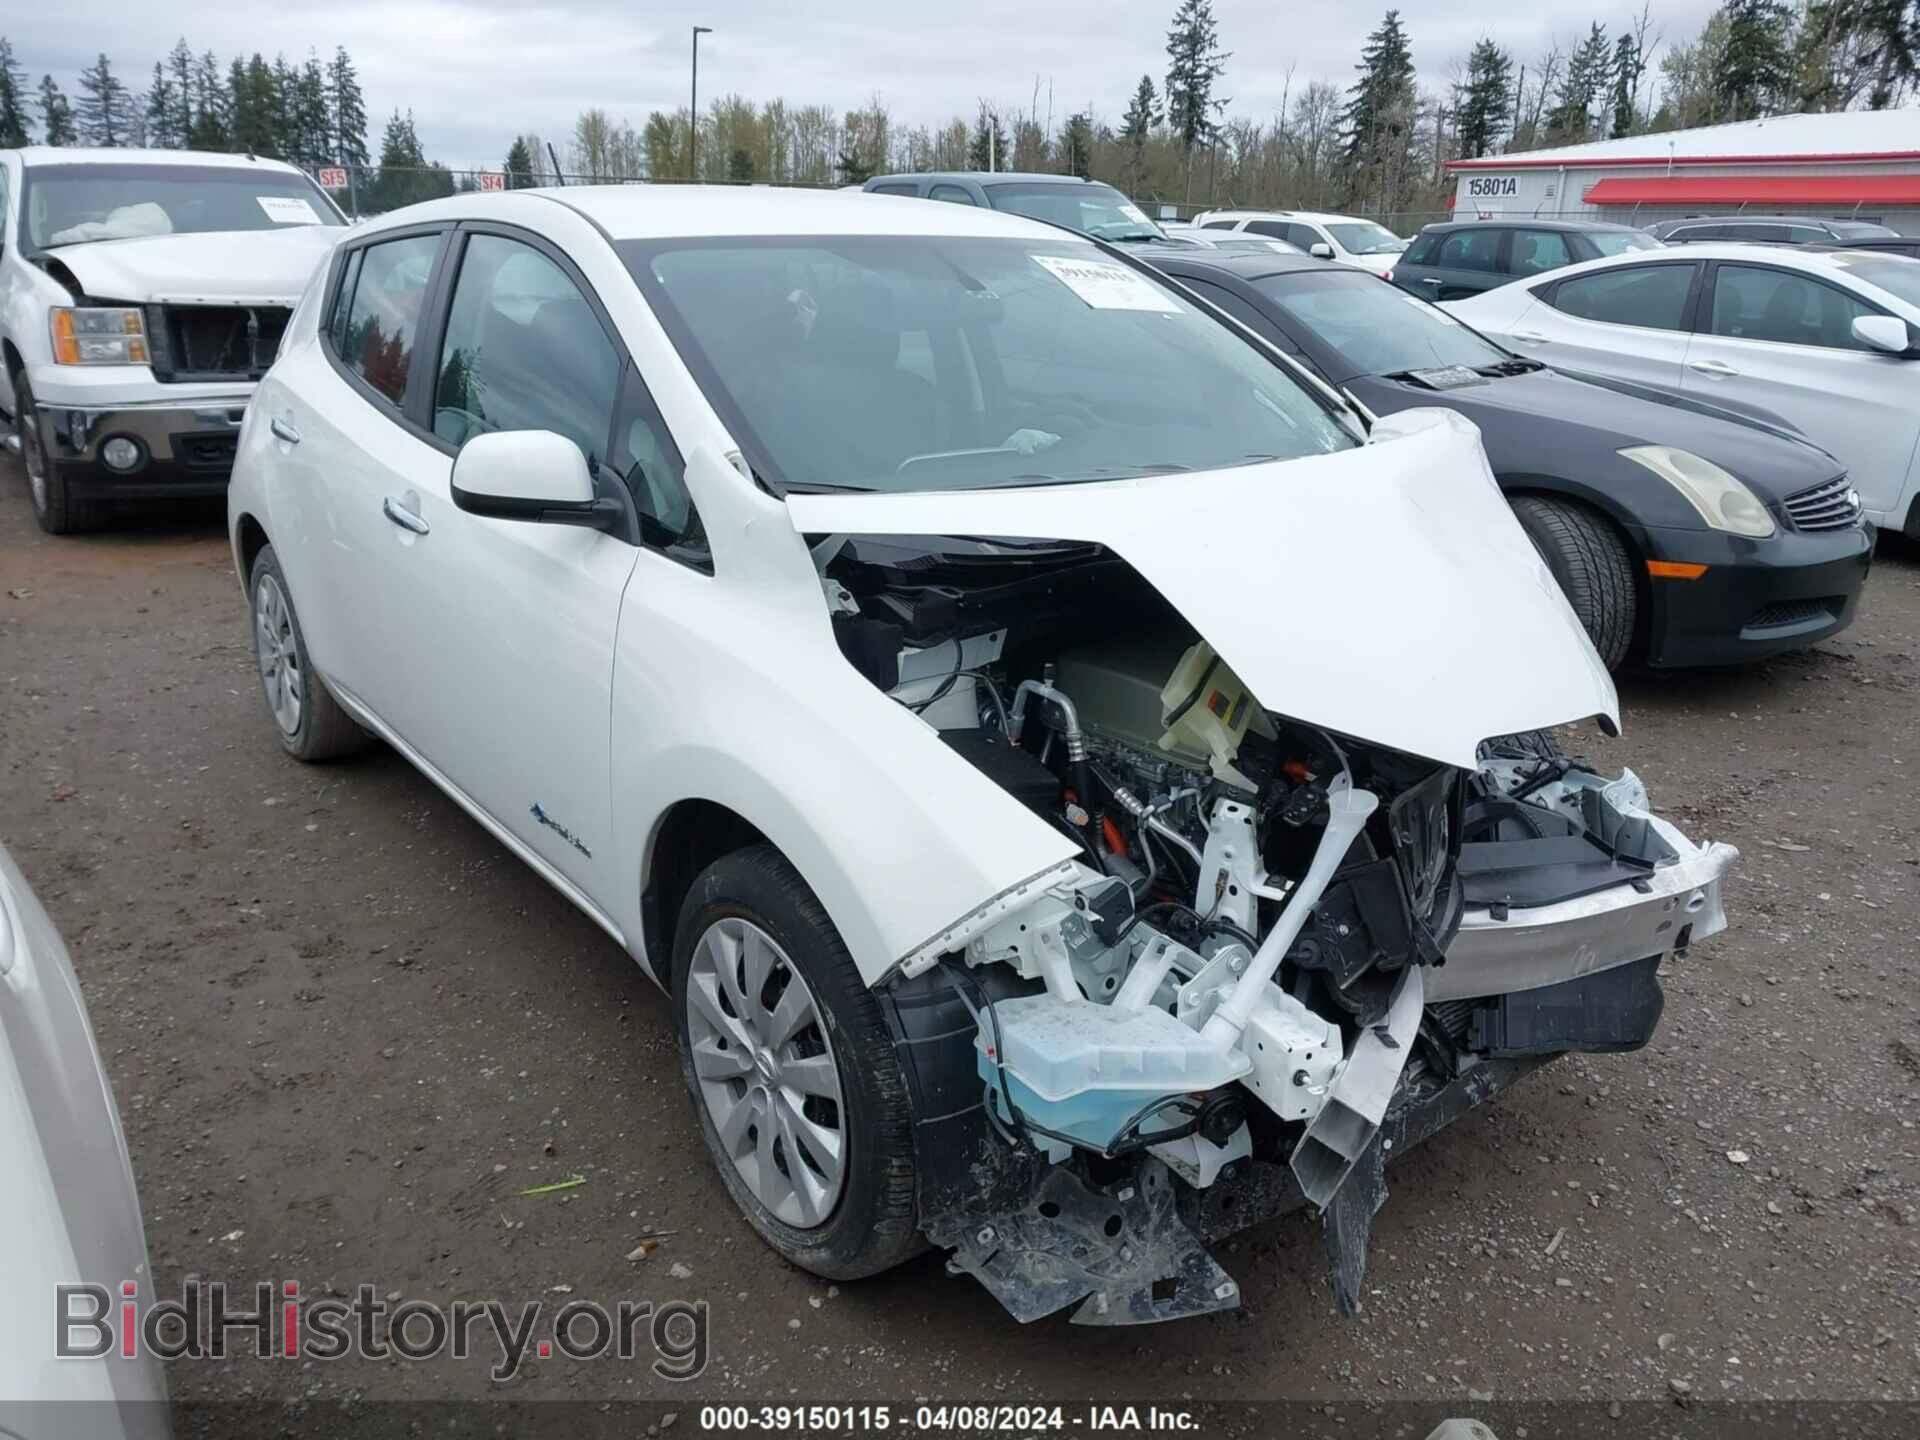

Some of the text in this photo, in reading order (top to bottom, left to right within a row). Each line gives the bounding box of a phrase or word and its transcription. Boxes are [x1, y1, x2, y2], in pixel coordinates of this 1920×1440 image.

[321, 170, 345, 185] SF5
[482, 175, 502, 190] SF4
[1469, 178, 1516, 195] 15801A
